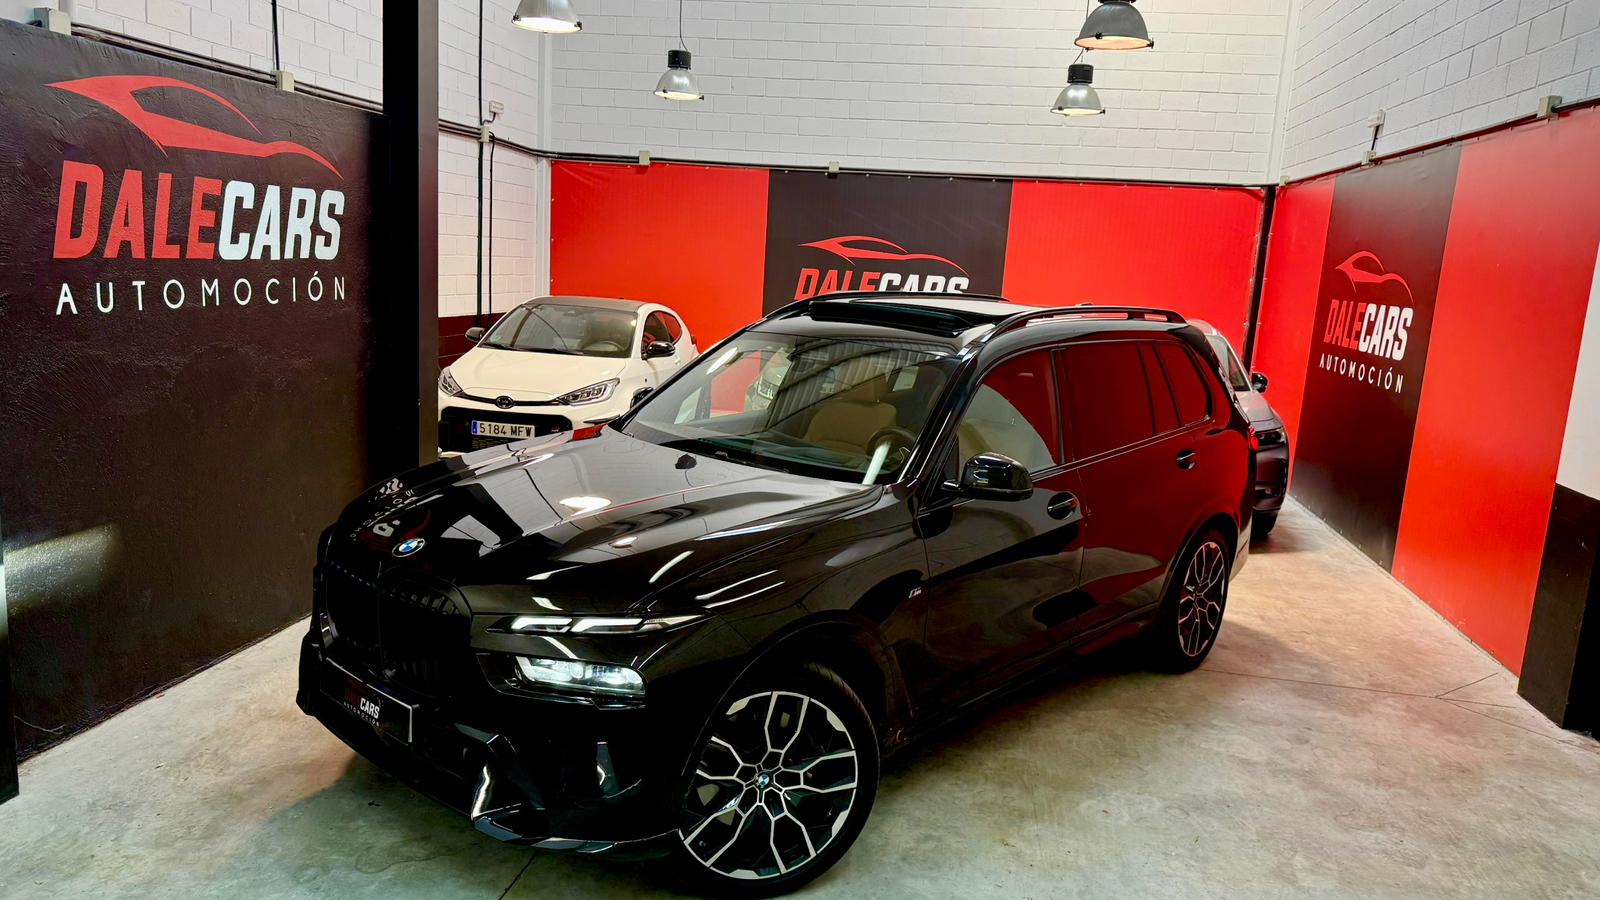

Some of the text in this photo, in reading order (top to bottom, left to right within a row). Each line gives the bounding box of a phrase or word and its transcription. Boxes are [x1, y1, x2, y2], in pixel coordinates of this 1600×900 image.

[52, 160, 346, 261] DALECARS
[55, 270, 346, 315] AUTOMOCIÓN
[1323, 298, 1414, 361] DALECARS
[1318, 352, 1404, 394] AUTOMOCIÓN
[479, 422, 508, 436] 5184
[510, 425, 533, 438] MFW
